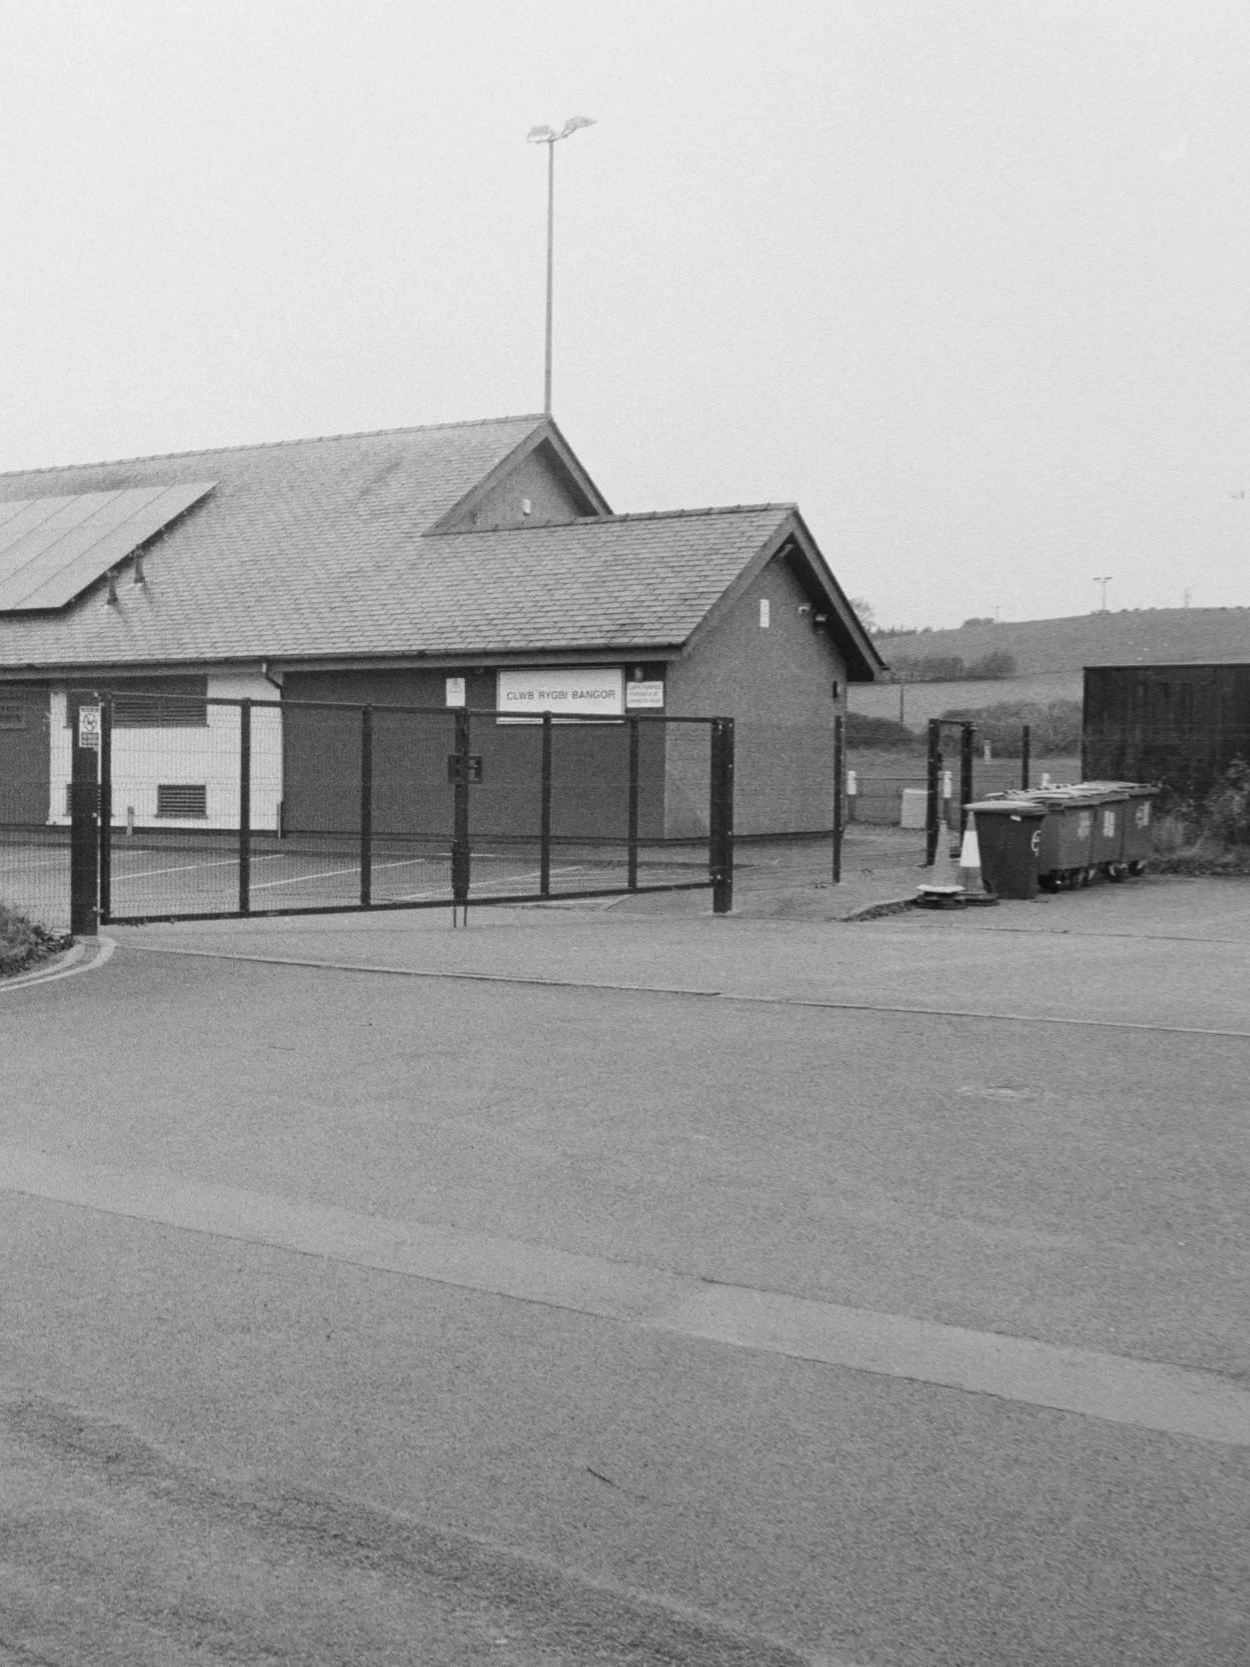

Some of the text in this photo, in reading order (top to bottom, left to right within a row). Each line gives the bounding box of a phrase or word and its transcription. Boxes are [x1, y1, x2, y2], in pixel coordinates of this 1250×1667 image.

[506, 690, 615, 701] CLWB RYGBI BANGOR
